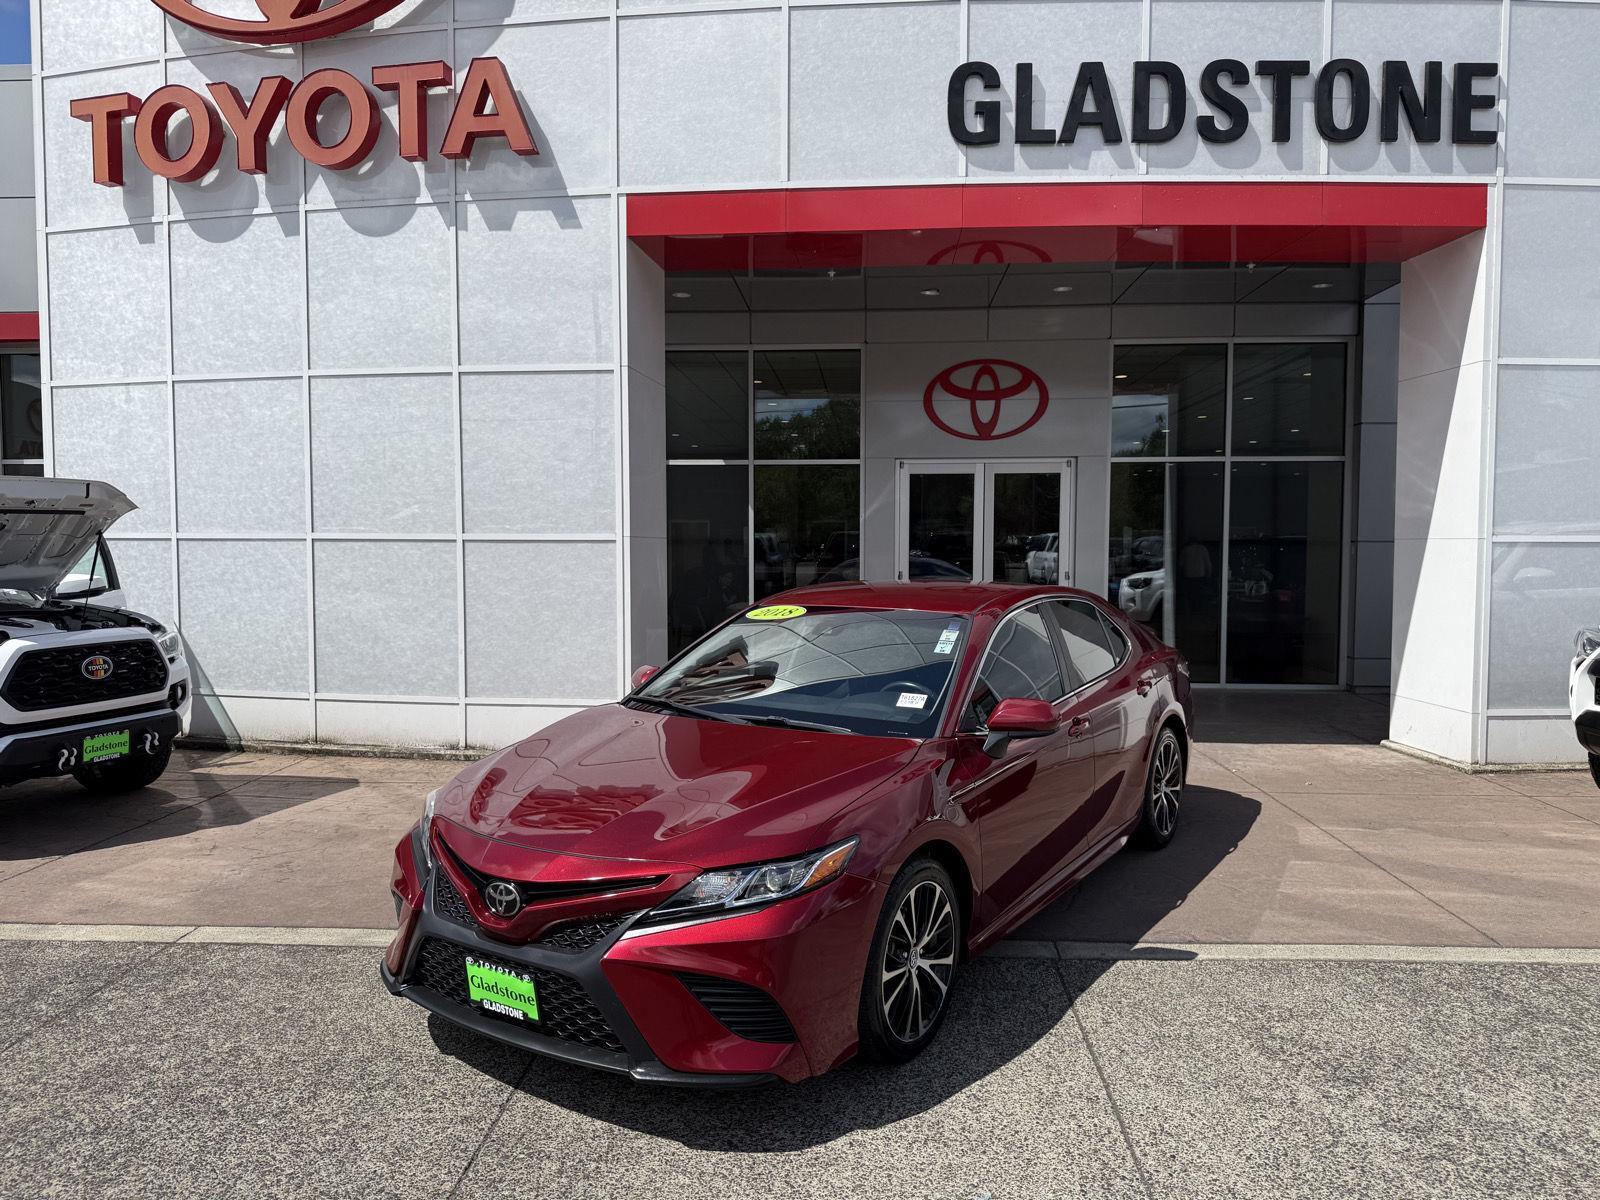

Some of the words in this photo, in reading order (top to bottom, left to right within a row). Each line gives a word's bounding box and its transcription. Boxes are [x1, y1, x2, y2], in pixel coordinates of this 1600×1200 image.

[947, 58, 1499, 147] GLADSTONE
[70, 56, 540, 187] TOYOTA
[84, 740, 128, 754] Gladstone
[93, 753, 120, 762] GLADSTONE
[479, 960, 516, 977] TOYOTA
[470, 974, 535, 1006] Gladstone
[483, 999, 524, 1020] GLADSTONE
